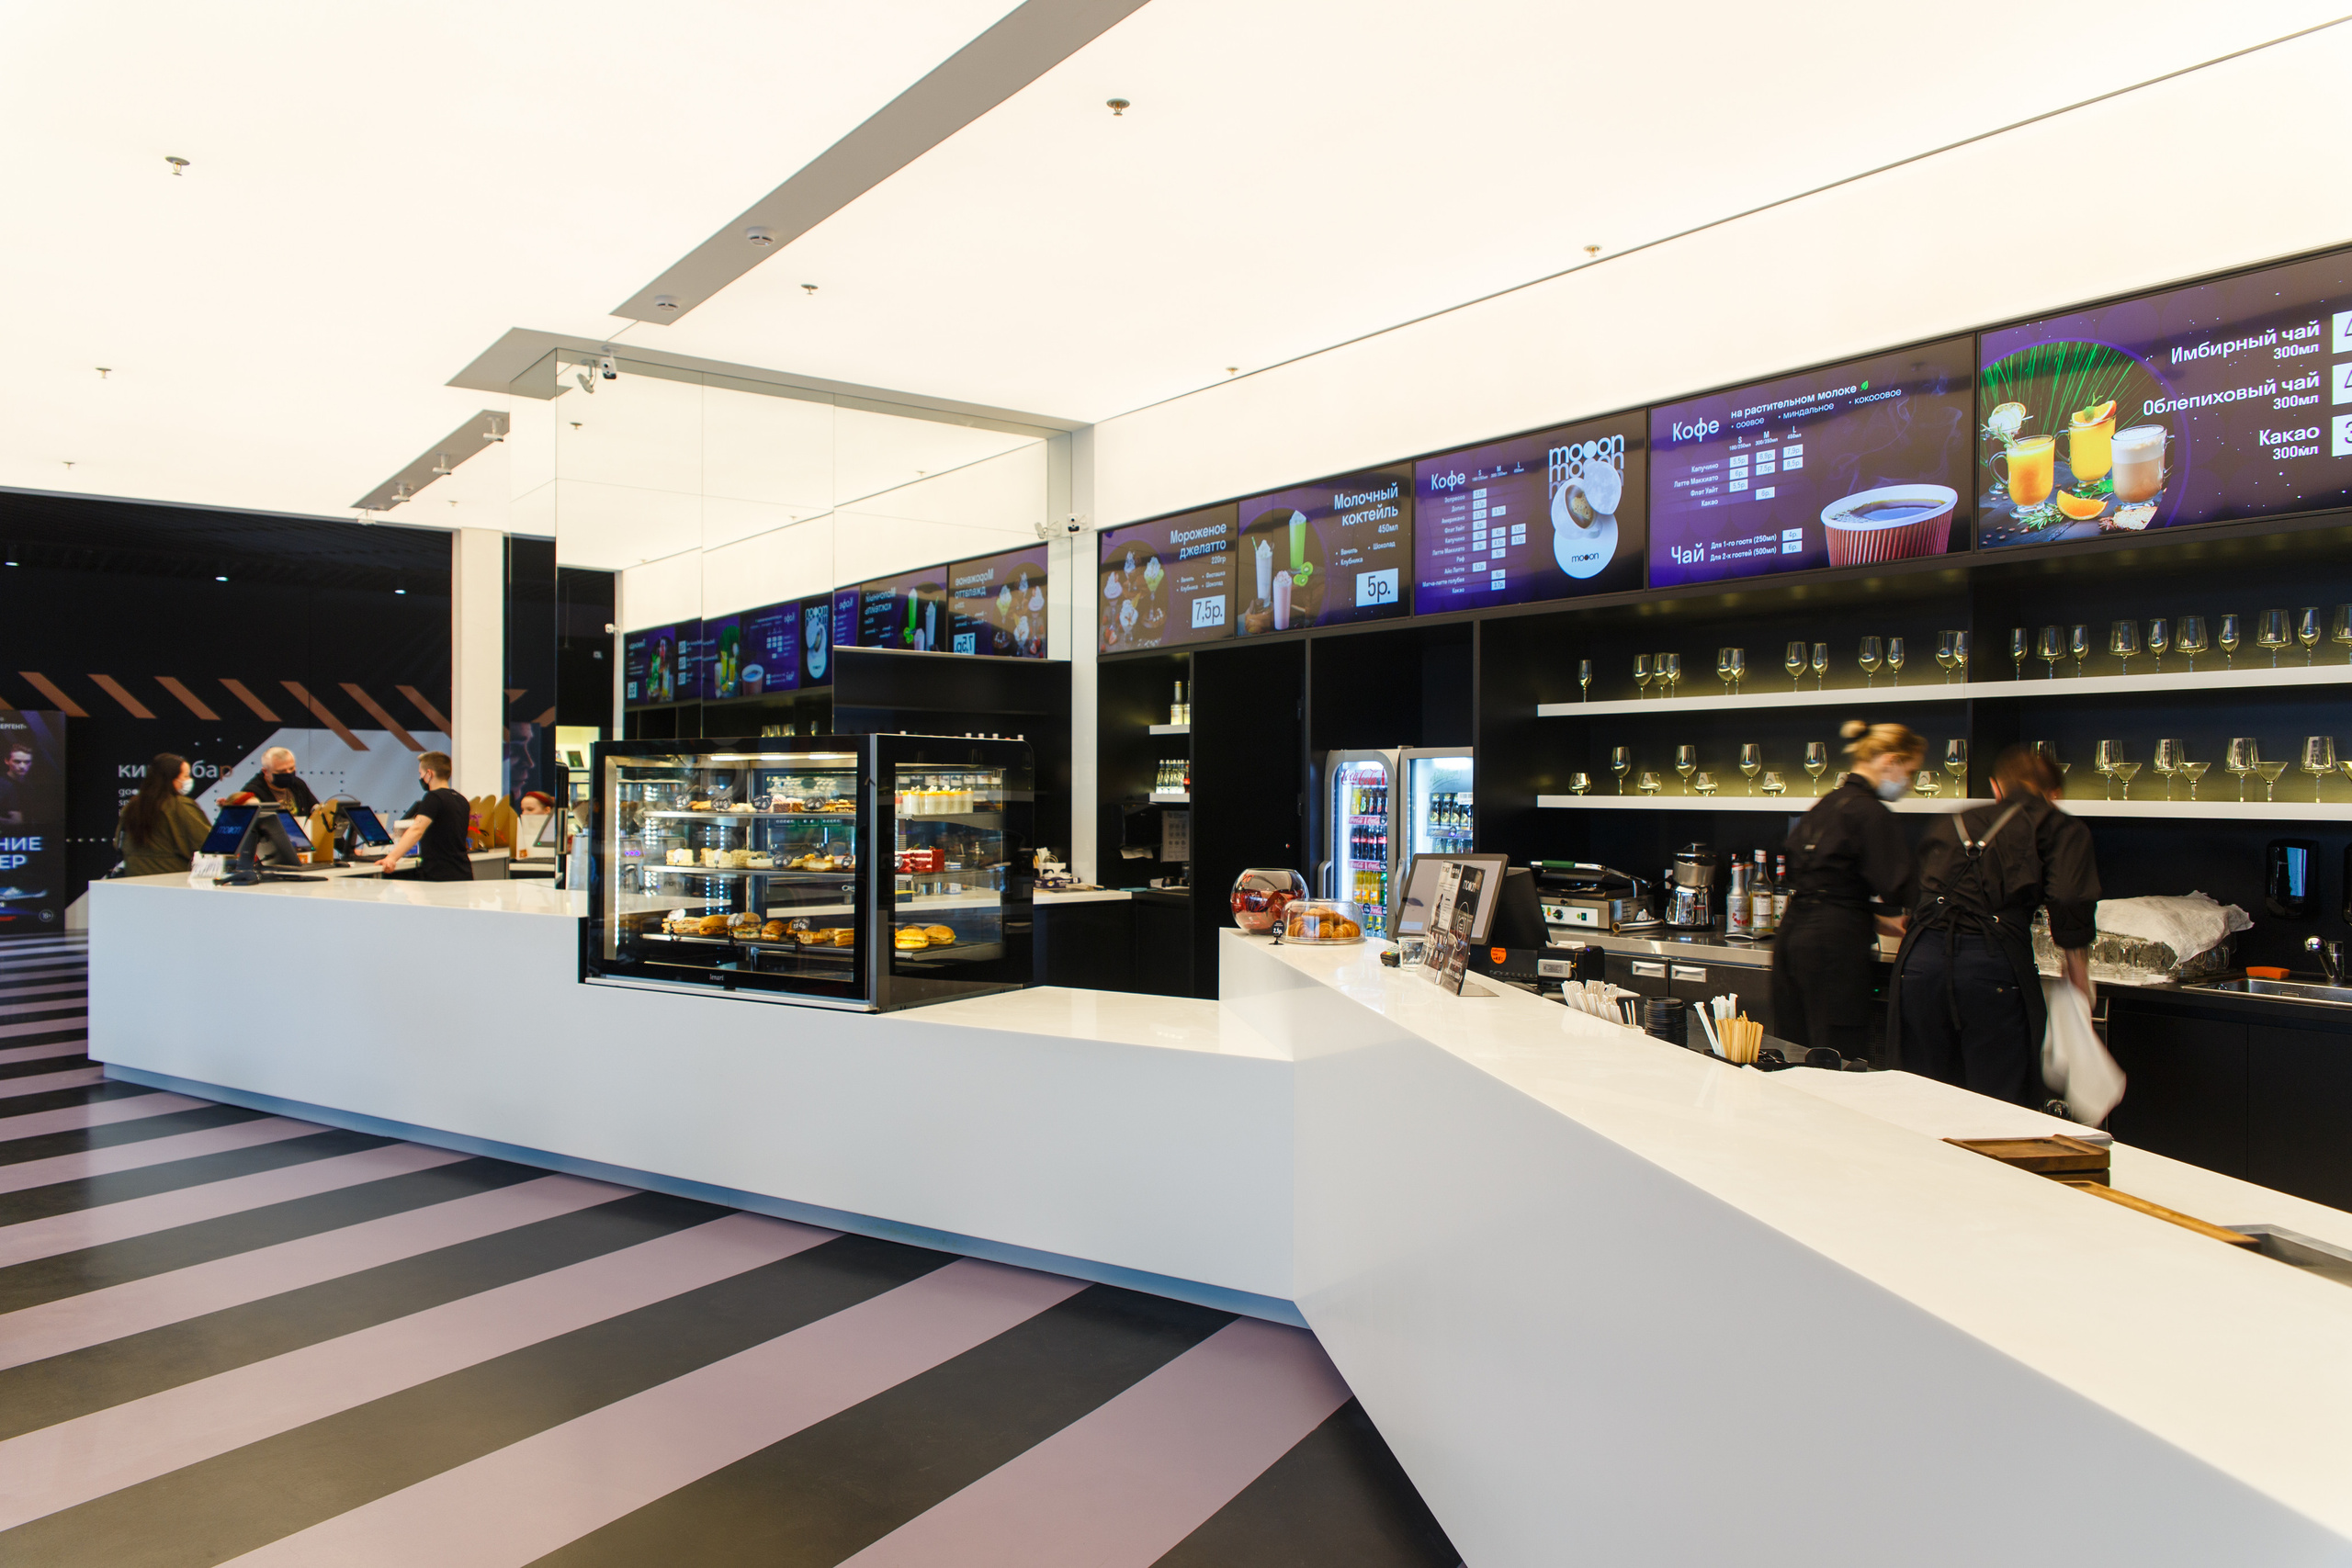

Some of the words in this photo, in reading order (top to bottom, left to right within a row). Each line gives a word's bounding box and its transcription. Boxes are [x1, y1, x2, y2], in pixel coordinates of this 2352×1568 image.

[2171, 328, 2277, 365] Имбирный
[2281, 320, 2321, 341] чай
[2273, 344, 2320, 360] 300мл
[2281, 371, 2321, 391] чай
[1731, 411, 1743, 419] на
[1745, 394, 1815, 419] растительном
[1817, 385, 1857, 401] молоке
[1736, 417, 1765, 430] соевое
[1782, 403, 1835, 420] миндальное
[1854, 389, 1902, 405] кокосовое
[2272, 394, 2319, 410] 300мл
[1672, 417, 1720, 443] Кофе
[1763, 431, 1770, 439] M
[2258, 426, 2321, 446] Какао
[2272, 445, 2319, 460] 300мл
[1691, 463, 1719, 473] Капучино
[1430, 470, 1465, 491] Кофе
[1674, 479, 1690, 488] Латте
[1690, 475, 1719, 485] Маккиато
[1334, 481, 1398, 511] Молочный
[1701, 499, 1719, 507] Какао
[1341, 503, 1399, 527] коктейль
[1170, 523, 1227, 546] Мороженое
[1377, 524, 1398, 534] 450мл
[1179, 539, 1227, 560] джелатто
[1711, 542, 1722, 550] Для
[1723, 540, 1736, 548] 1-го
[1736, 537, 1753, 547] гостя
[1753, 534, 1777, 545] (250мл)
[1211, 556, 1227, 565] 220гр
[1671, 542, 1704, 565] Чай
[1710, 554, 1722, 562] Для
[1722, 552, 1732, 560] 2-х
[1732, 549, 1753, 559] гостей
[1753, 547, 1777, 557] (500мл)
[1367, 575, 1391, 604] 5р.
[1195, 600, 1223, 625] 7,5р.
